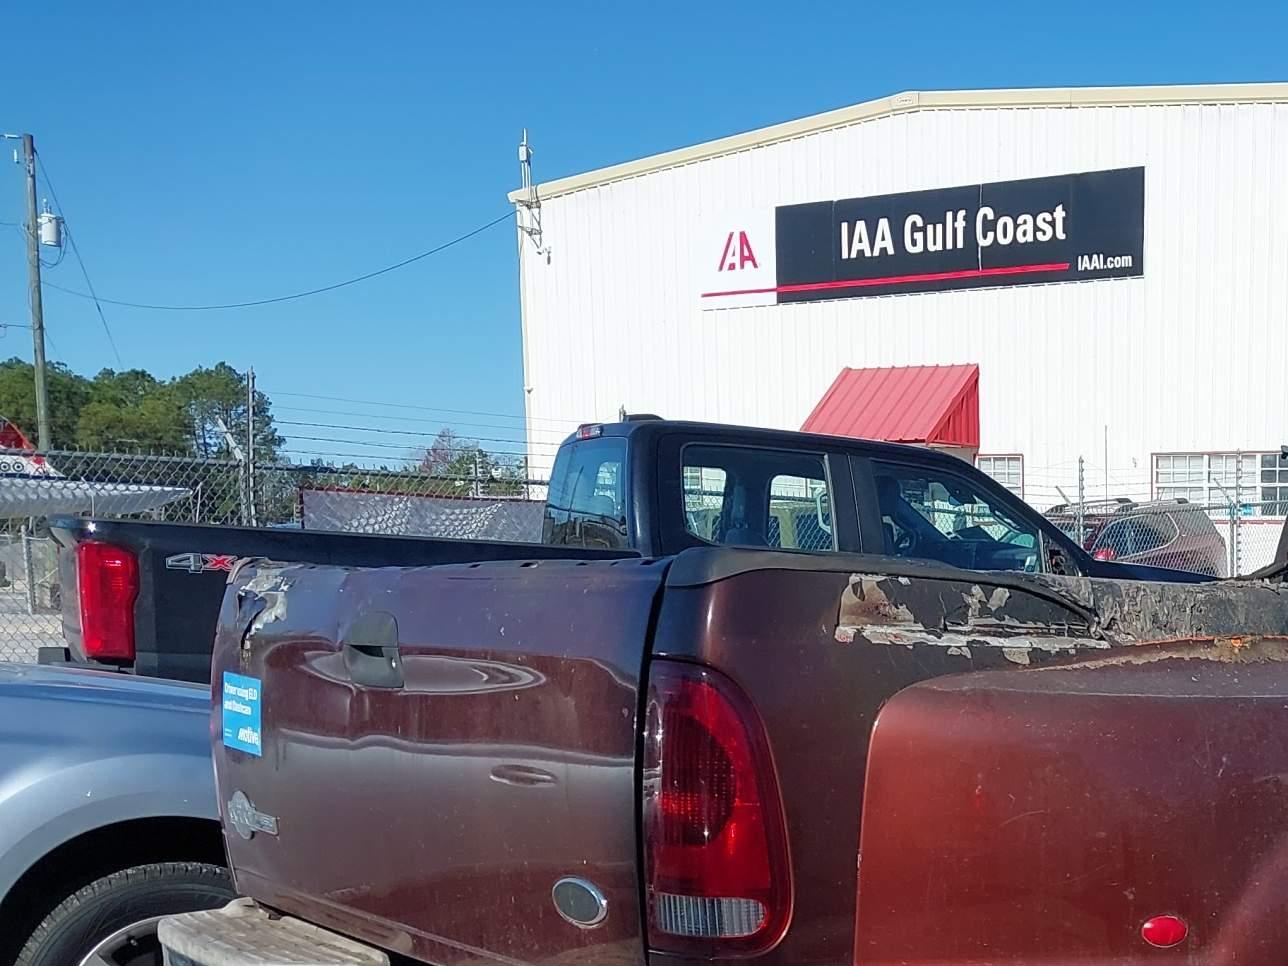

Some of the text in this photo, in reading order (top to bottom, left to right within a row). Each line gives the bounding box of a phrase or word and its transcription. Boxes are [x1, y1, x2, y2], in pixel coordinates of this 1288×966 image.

[840, 203, 1067, 260] IAA Gulf Coast
[1077, 253, 1133, 272] IAAI.com
[166, 553, 238, 573] 4X
